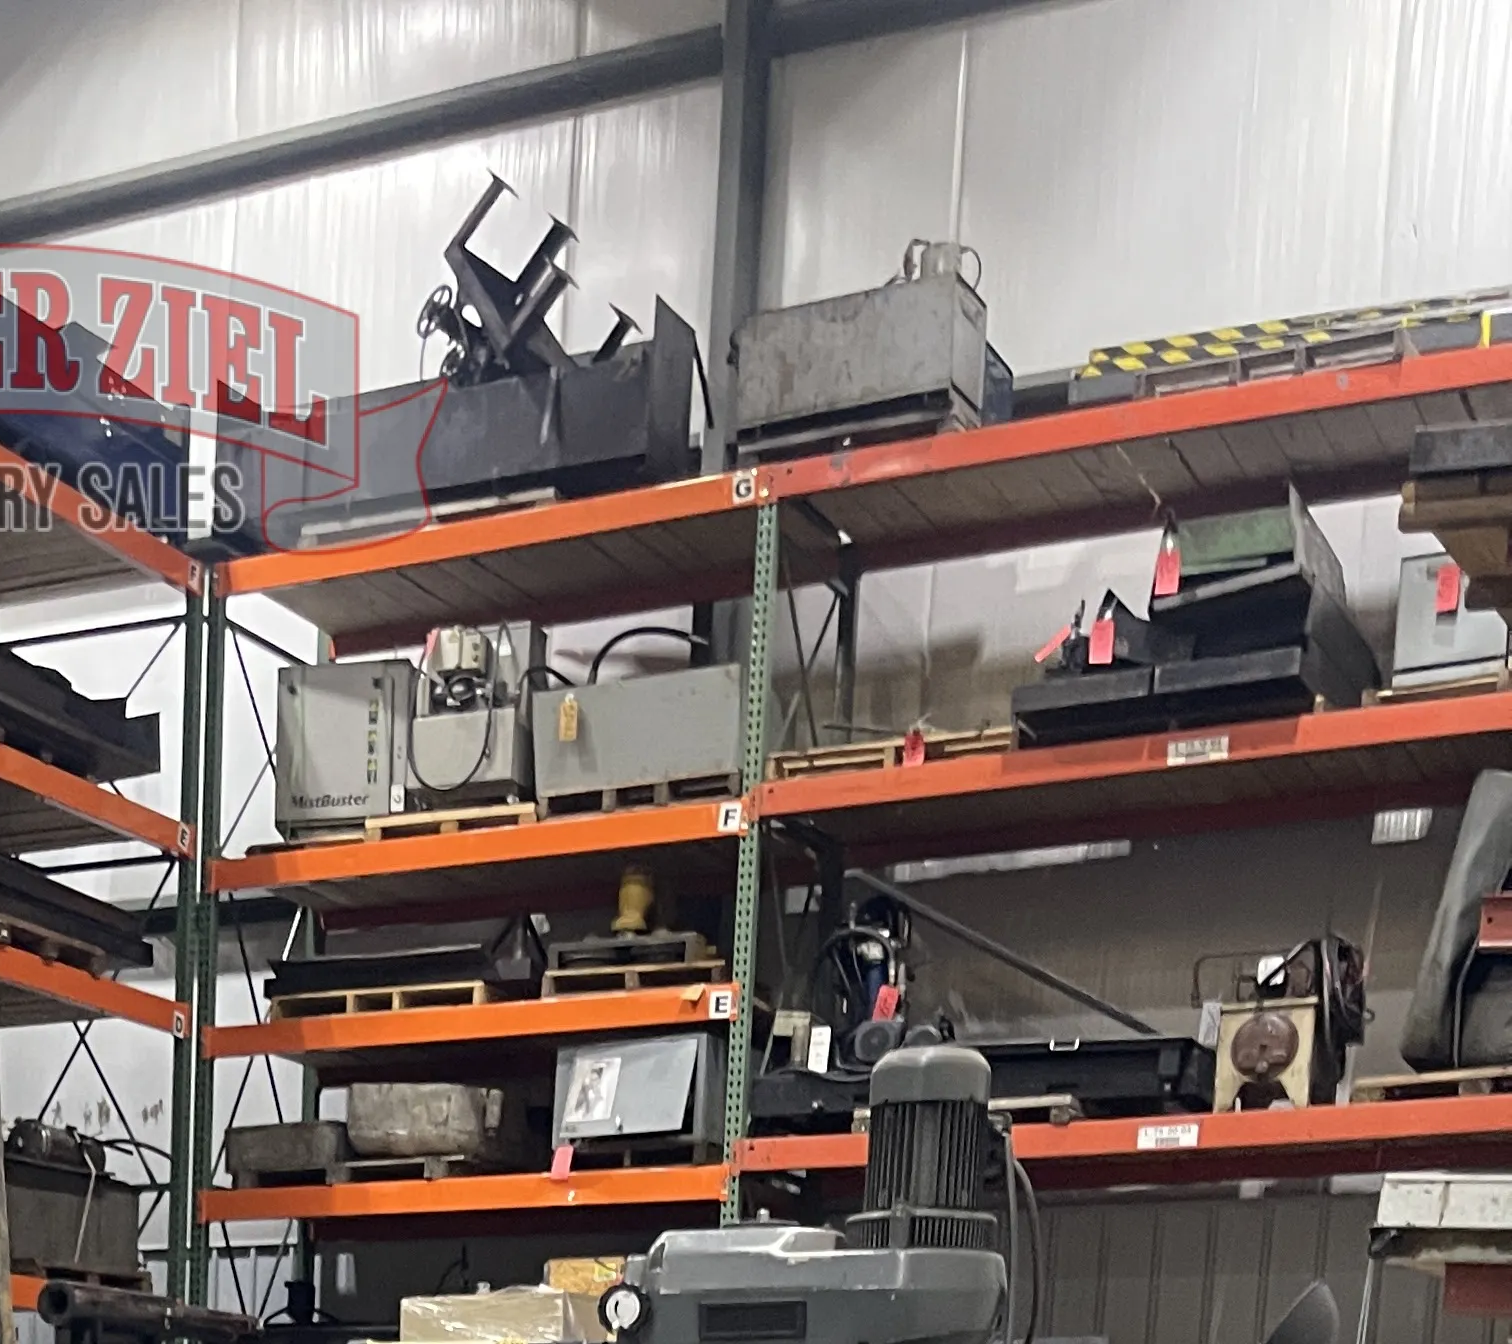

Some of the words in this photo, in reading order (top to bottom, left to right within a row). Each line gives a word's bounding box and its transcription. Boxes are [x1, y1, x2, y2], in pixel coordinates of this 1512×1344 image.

[735, 479, 752, 498] G
[722, 808, 738, 827] F
[181, 829, 187, 845] E
[714, 996, 729, 1014] E
[175, 1016, 183, 1033] D
